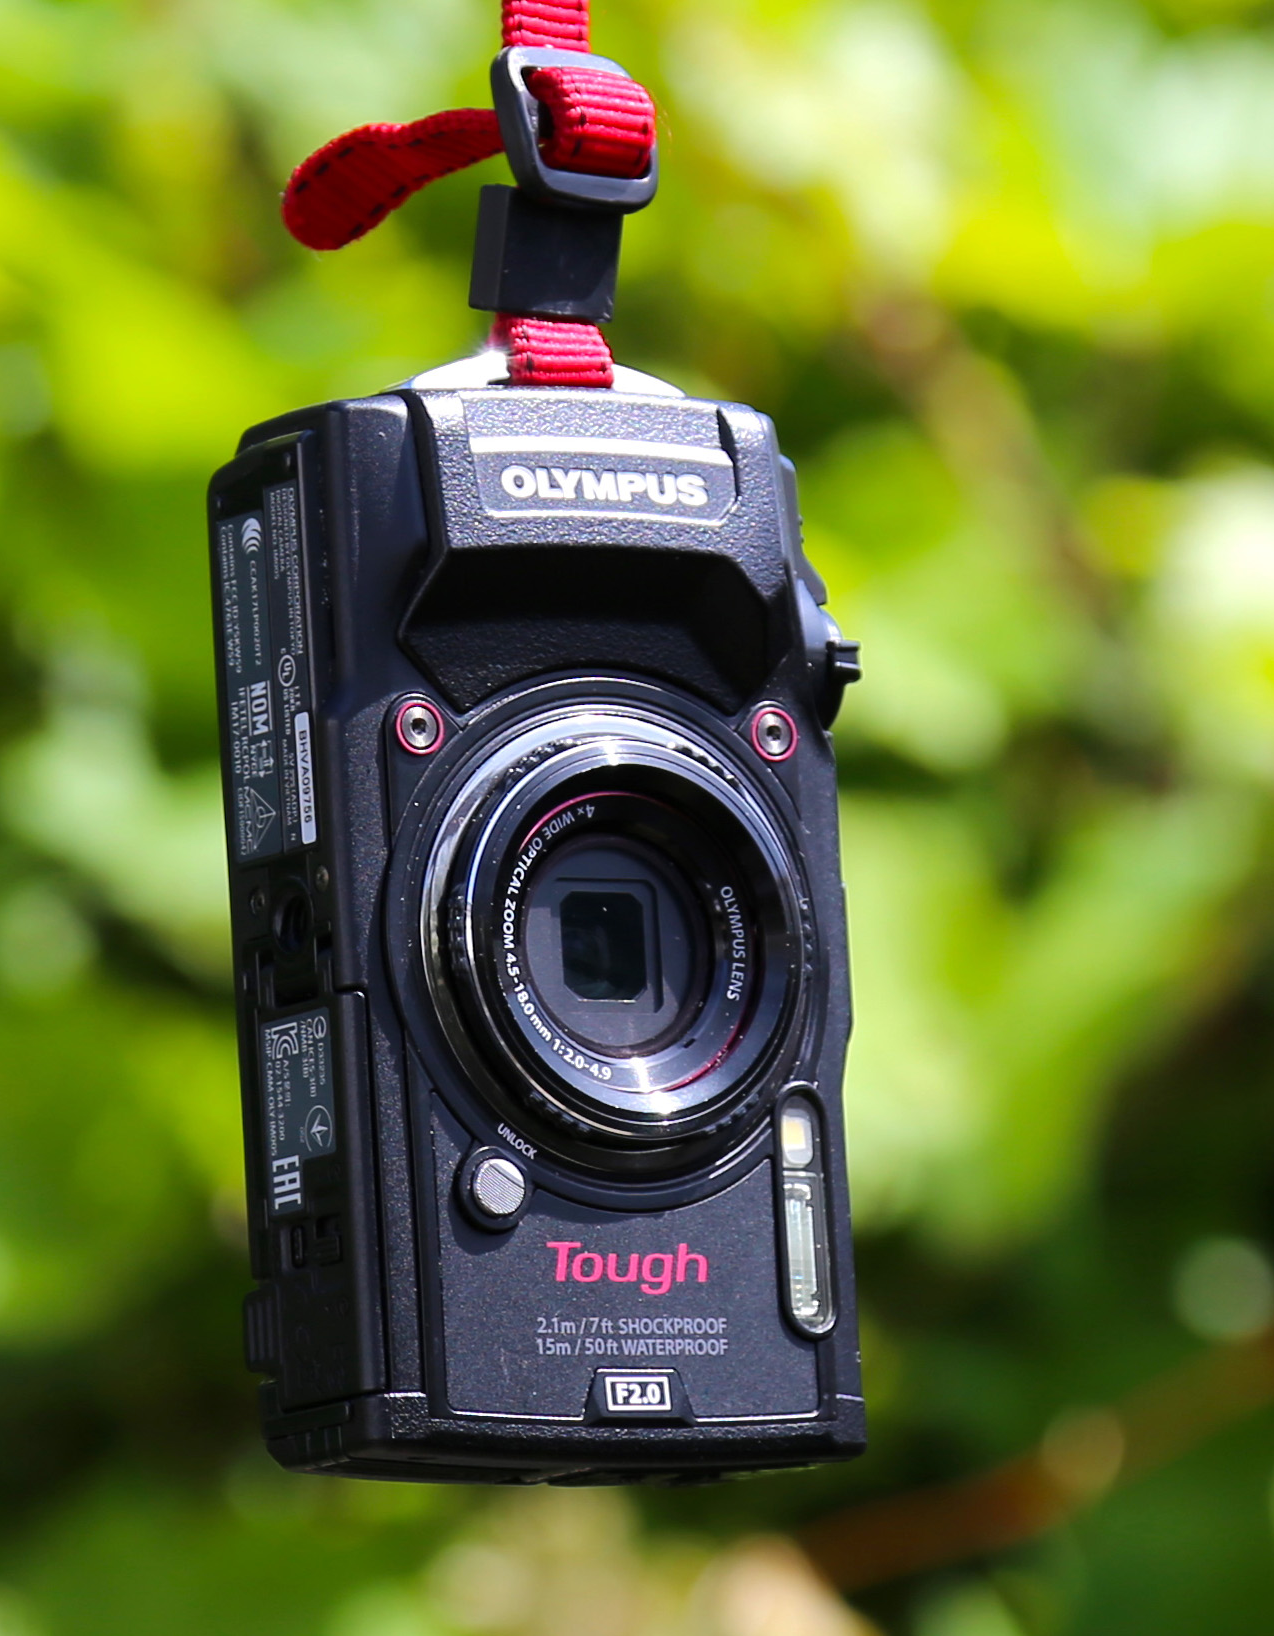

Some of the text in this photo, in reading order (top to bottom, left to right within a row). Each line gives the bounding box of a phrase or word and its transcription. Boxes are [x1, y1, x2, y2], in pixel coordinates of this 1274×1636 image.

[500, 464, 709, 506] OLYMPUS
[270, 492, 278, 526] MODEL
[275, 489, 286, 572] DIGITAL CAMERA
[220, 526, 229, 579] Contains
[227, 524, 236, 577] Contains
[288, 487, 304, 654] OLYMPUS CORPORATION
[230, 579, 239, 603] FCC
[285, 556, 294, 606] OLYMPUS
[289, 621, 297, 655] TOKYO
[250, 681, 269, 735] NOM
[250, 744, 258, 777] NYCE
[299, 730, 313, 824] BHVA09756
[244, 786, 253, 854] MCMC
[284, 781, 292, 825] VIETNAM
[542, 811, 576, 840] WIDE
[507, 837, 543, 895] OPTICAL
[502, 898, 517, 949] ZOOM
[720, 886, 746, 1001] OLYMPUS LENS
[306, 1018, 314, 1044] CAN
[552, 1038, 612, 1080] 1:2.0-4.9
[497, 1123, 537, 1160] UNLOCK
[272, 1154, 302, 1210] EAC
[545, 1241, 710, 1295] Tough
[536, 1317, 576, 1334] 2.1m
[618, 1317, 728, 1335] SHOCKPROOF
[536, 1339, 571, 1355] 15m
[620, 1338, 728, 1356] WATERPROOF
[615, 1382, 662, 1405] F2.0
